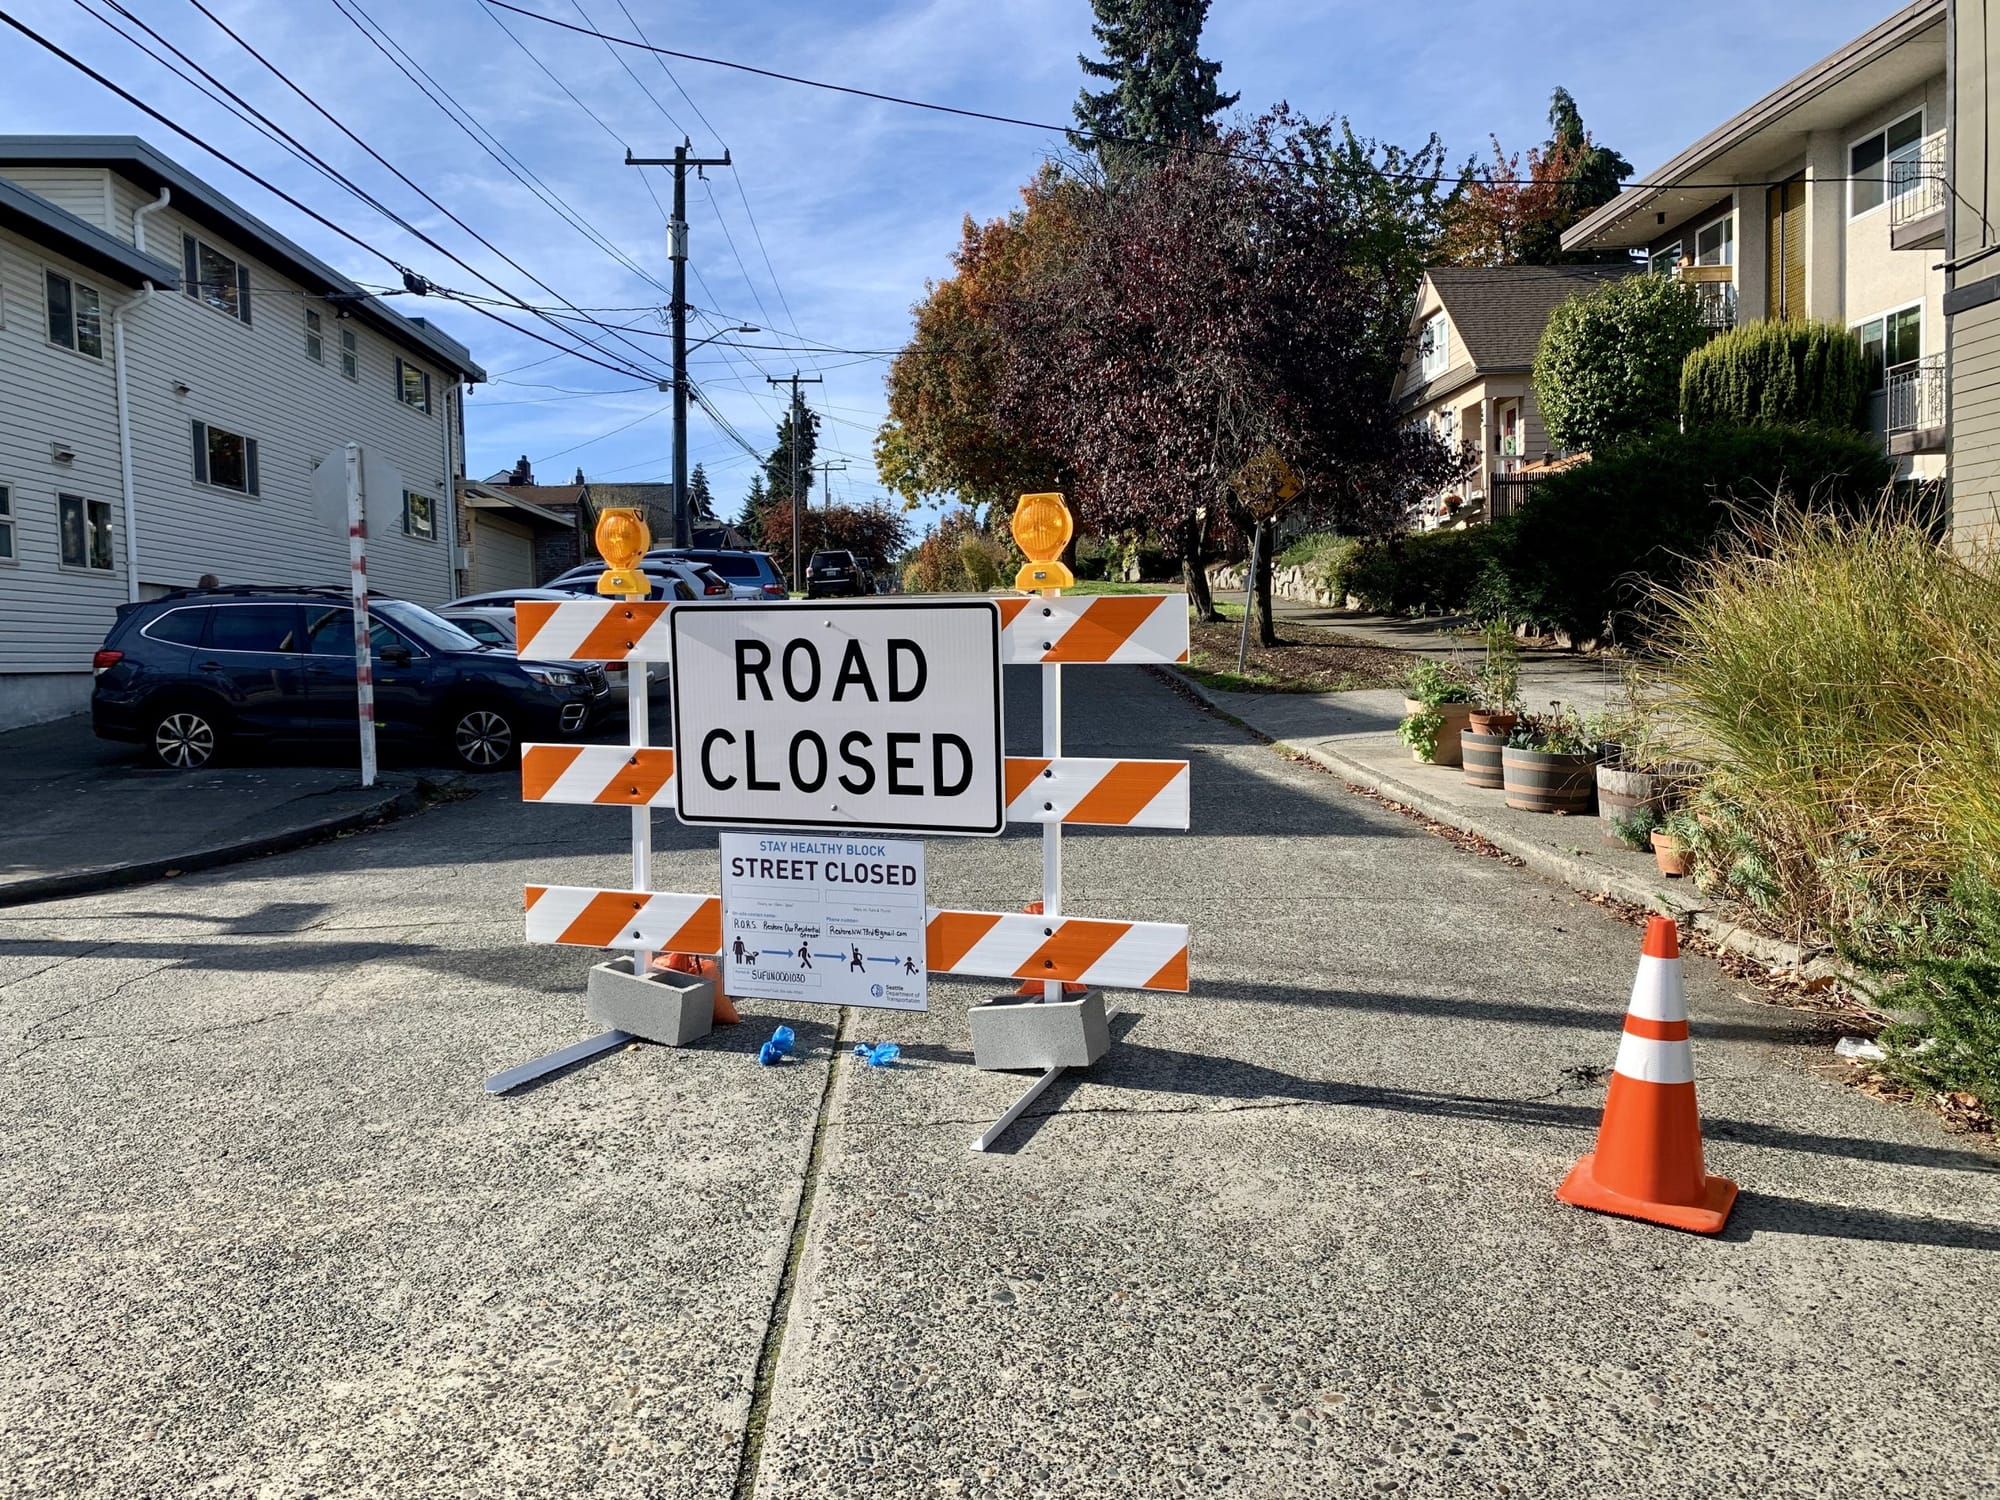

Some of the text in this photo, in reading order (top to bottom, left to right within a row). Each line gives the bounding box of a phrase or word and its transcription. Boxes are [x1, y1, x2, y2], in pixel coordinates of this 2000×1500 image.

[735, 637, 927, 702] ROAD
[701, 728, 973, 796] CLOSED
[732, 857, 917, 886] STREET CLOSED
[760, 841, 886, 857] STAY HEALTHY BLOCK
